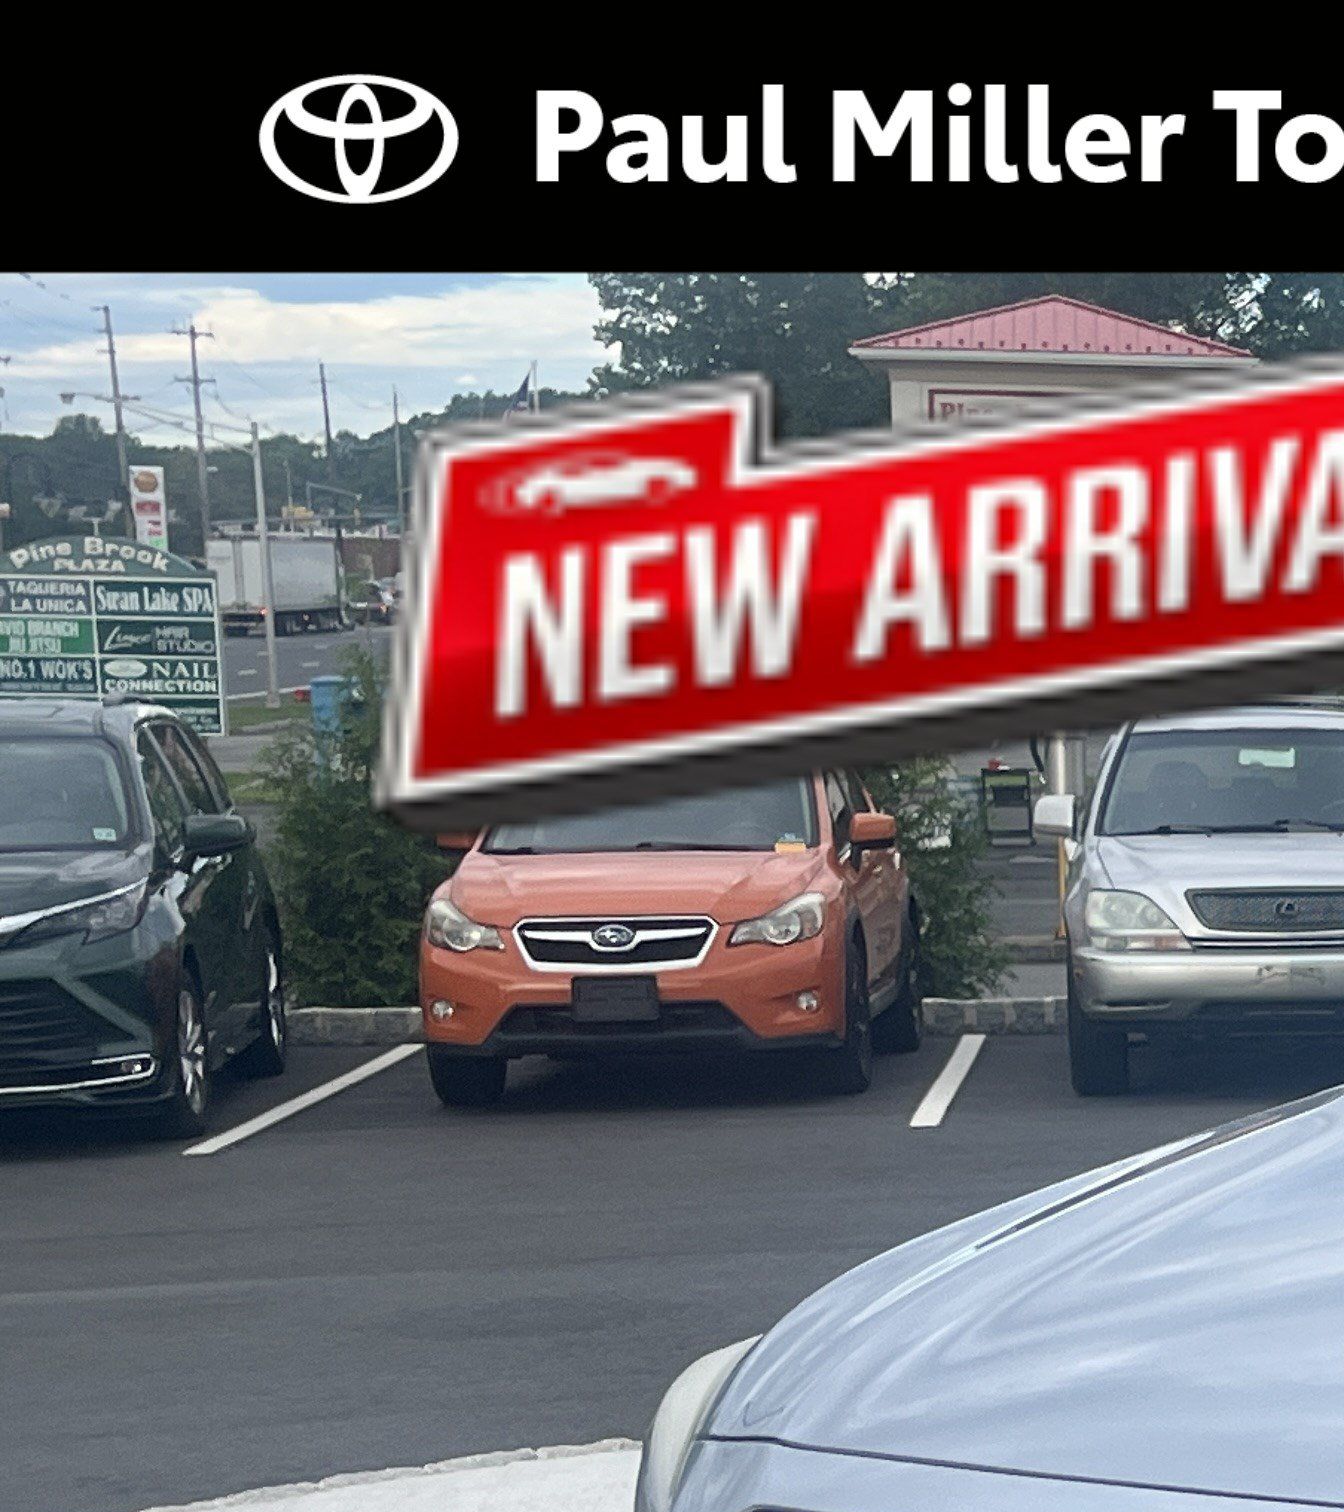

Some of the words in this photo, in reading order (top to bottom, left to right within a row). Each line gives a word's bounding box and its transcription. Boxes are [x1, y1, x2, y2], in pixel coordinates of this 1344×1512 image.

[9, 543, 72, 569] Pine
[84, 536, 169, 572] Brook
[53, 558, 126, 572] PLAZA
[7, 580, 86, 596] TAQUERIA
[11, 598, 32, 612] LA
[143, 586, 181, 612] Lake
[182, 587, 215, 612] SPA
[40, 659, 94, 680] WOK'S
[152, 662, 216, 679] NAIL
[104, 678, 217, 693] CONNECTION
